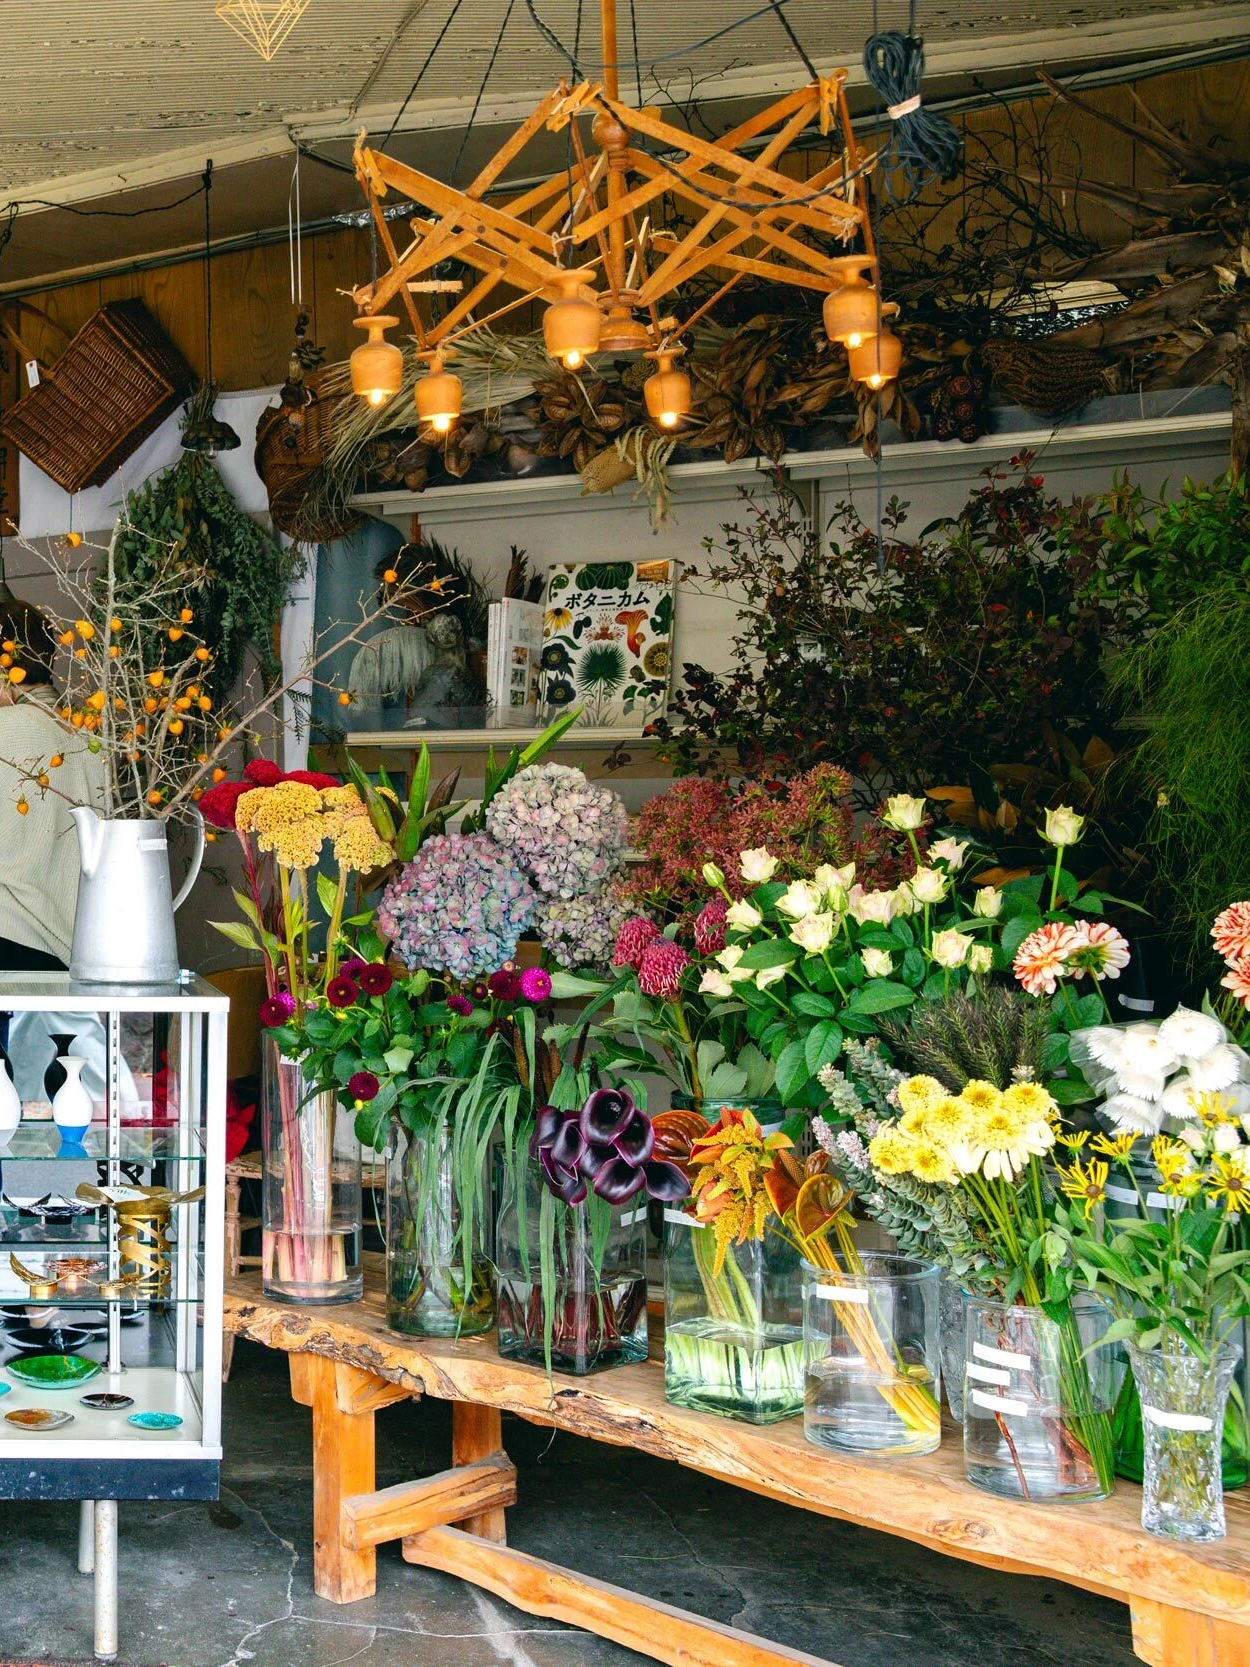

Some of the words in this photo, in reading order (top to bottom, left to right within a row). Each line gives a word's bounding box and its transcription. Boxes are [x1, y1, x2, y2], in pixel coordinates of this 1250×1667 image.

[564, 591, 651, 610] ボタニカム
